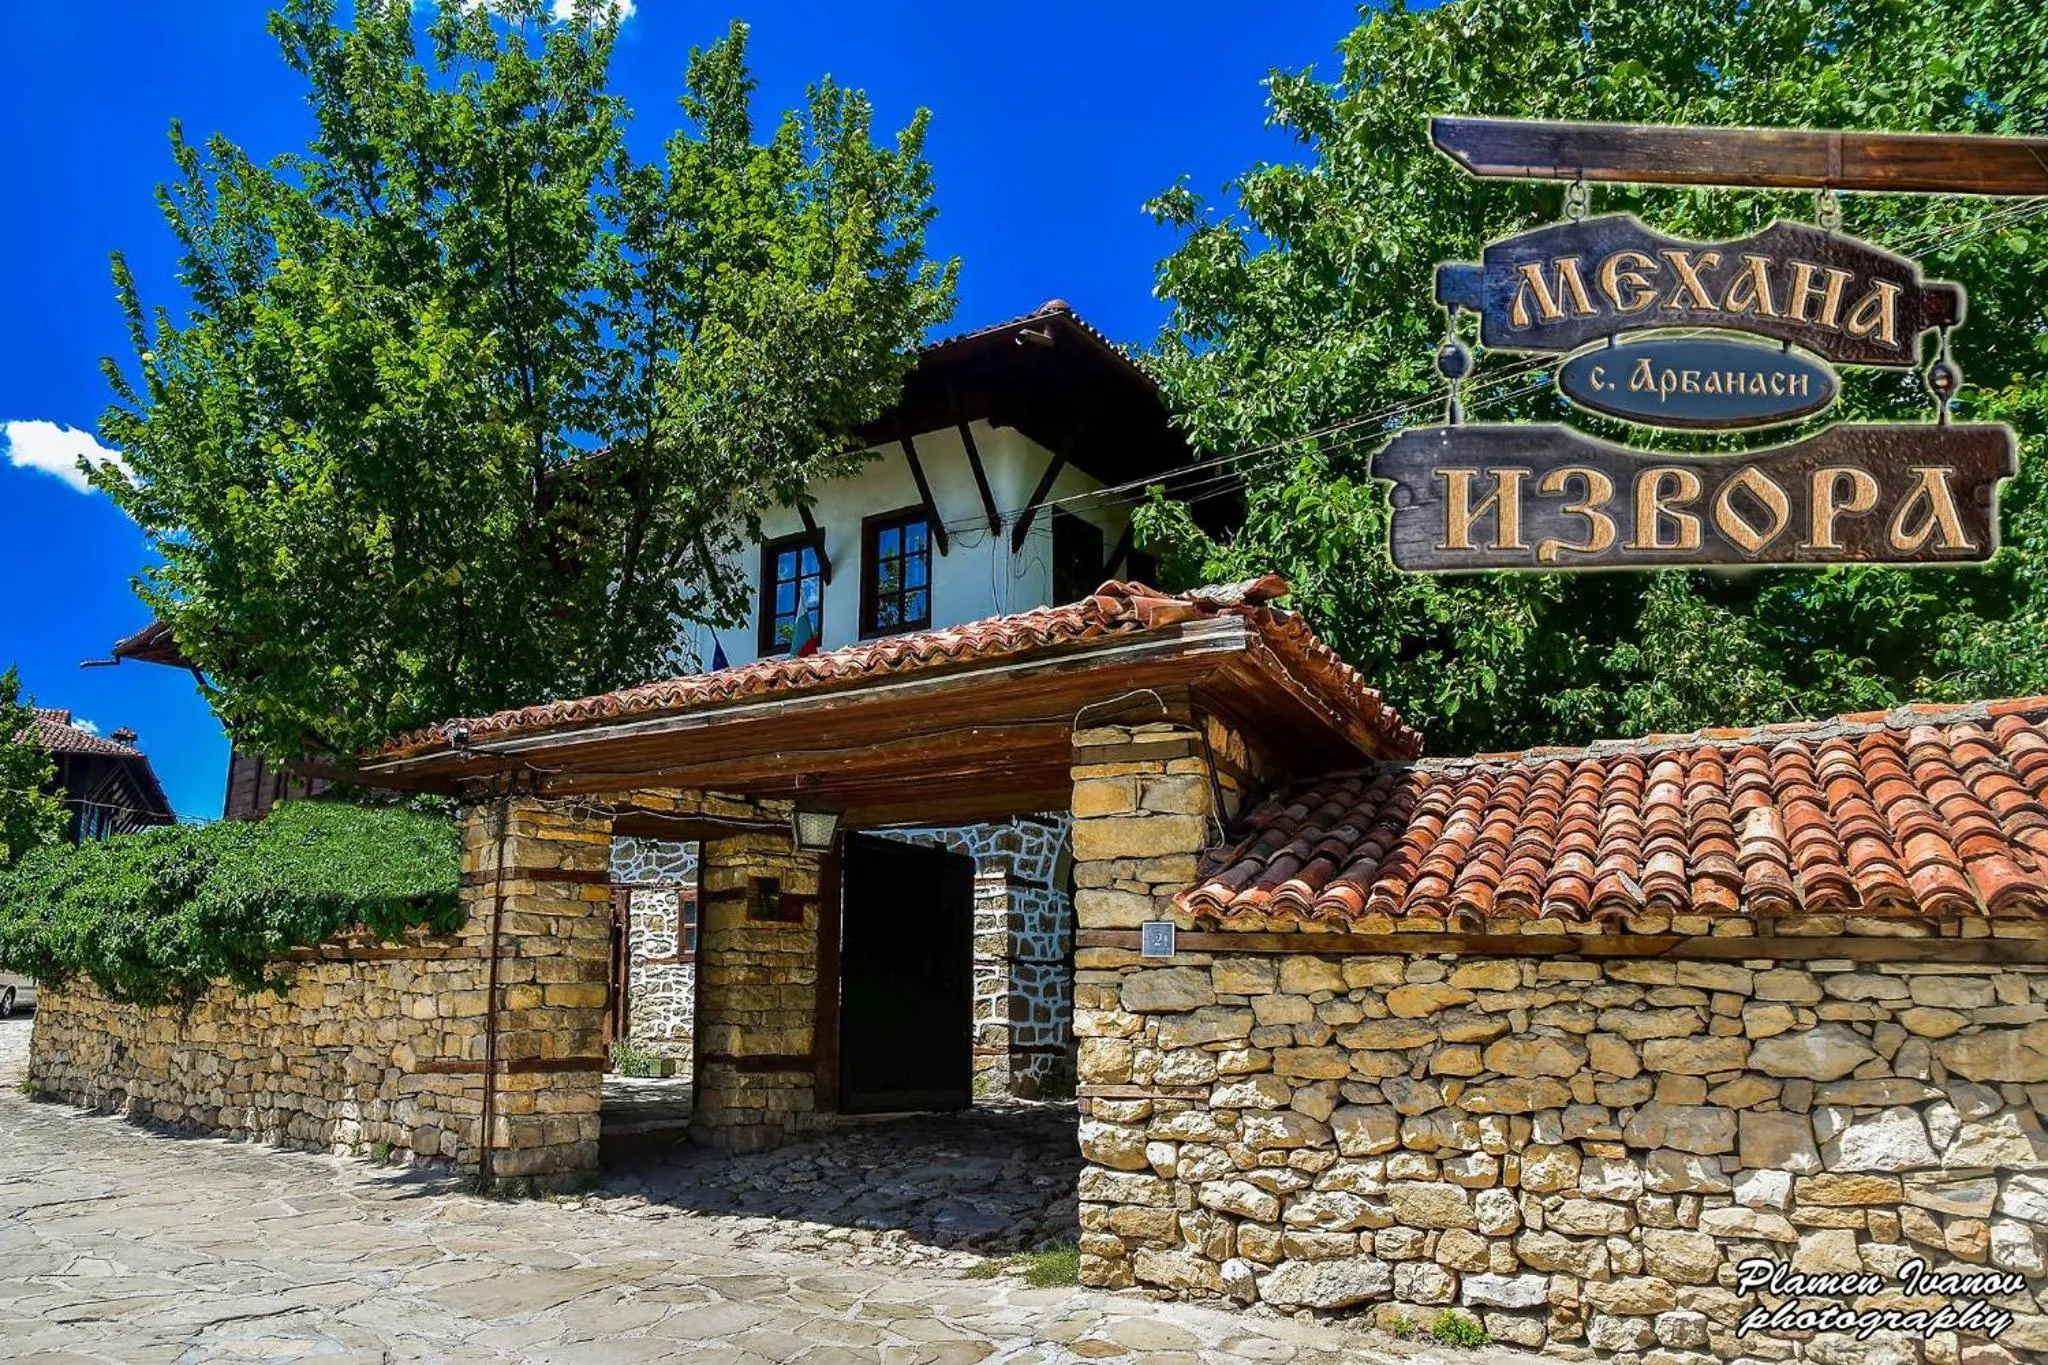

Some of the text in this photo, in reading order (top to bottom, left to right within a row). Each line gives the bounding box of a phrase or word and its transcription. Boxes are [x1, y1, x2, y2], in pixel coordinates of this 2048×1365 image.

[1589, 358, 1808, 401] с. Арбанаси
[1434, 465, 1976, 562] ИЗВОРА
